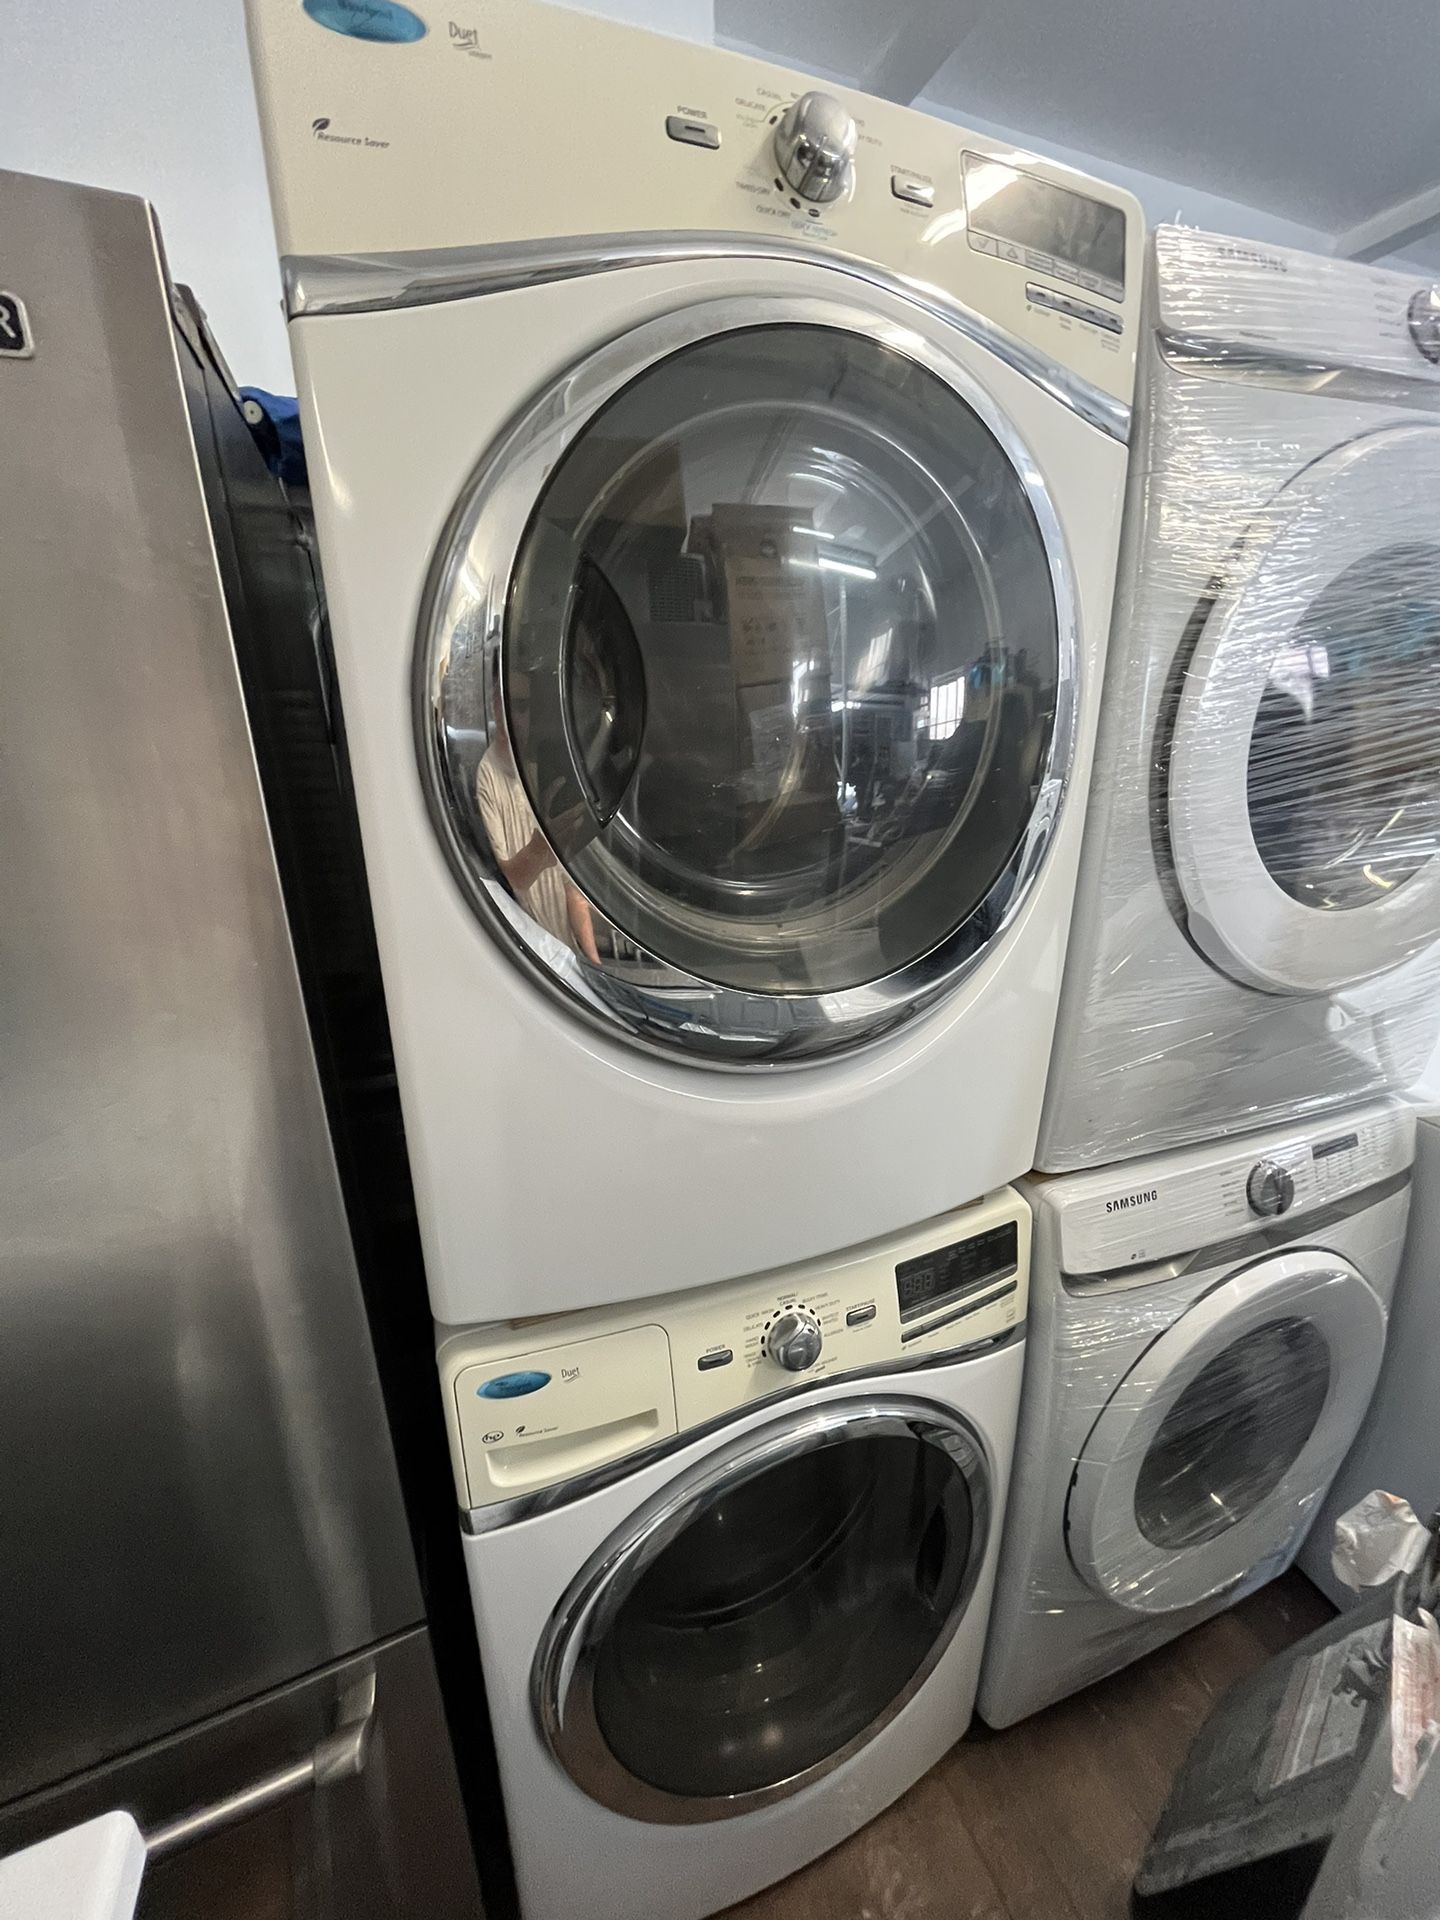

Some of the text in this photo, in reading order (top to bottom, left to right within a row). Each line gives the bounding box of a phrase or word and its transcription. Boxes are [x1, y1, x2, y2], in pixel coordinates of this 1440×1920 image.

[677, 104, 708, 119] POWER
[318, 131, 390, 149] Resource Saver
[1106, 1189, 1158, 1213] SAMSUNG
[706, 1343, 726, 1354] POWER
[561, 1366, 580, 1380] Duet
